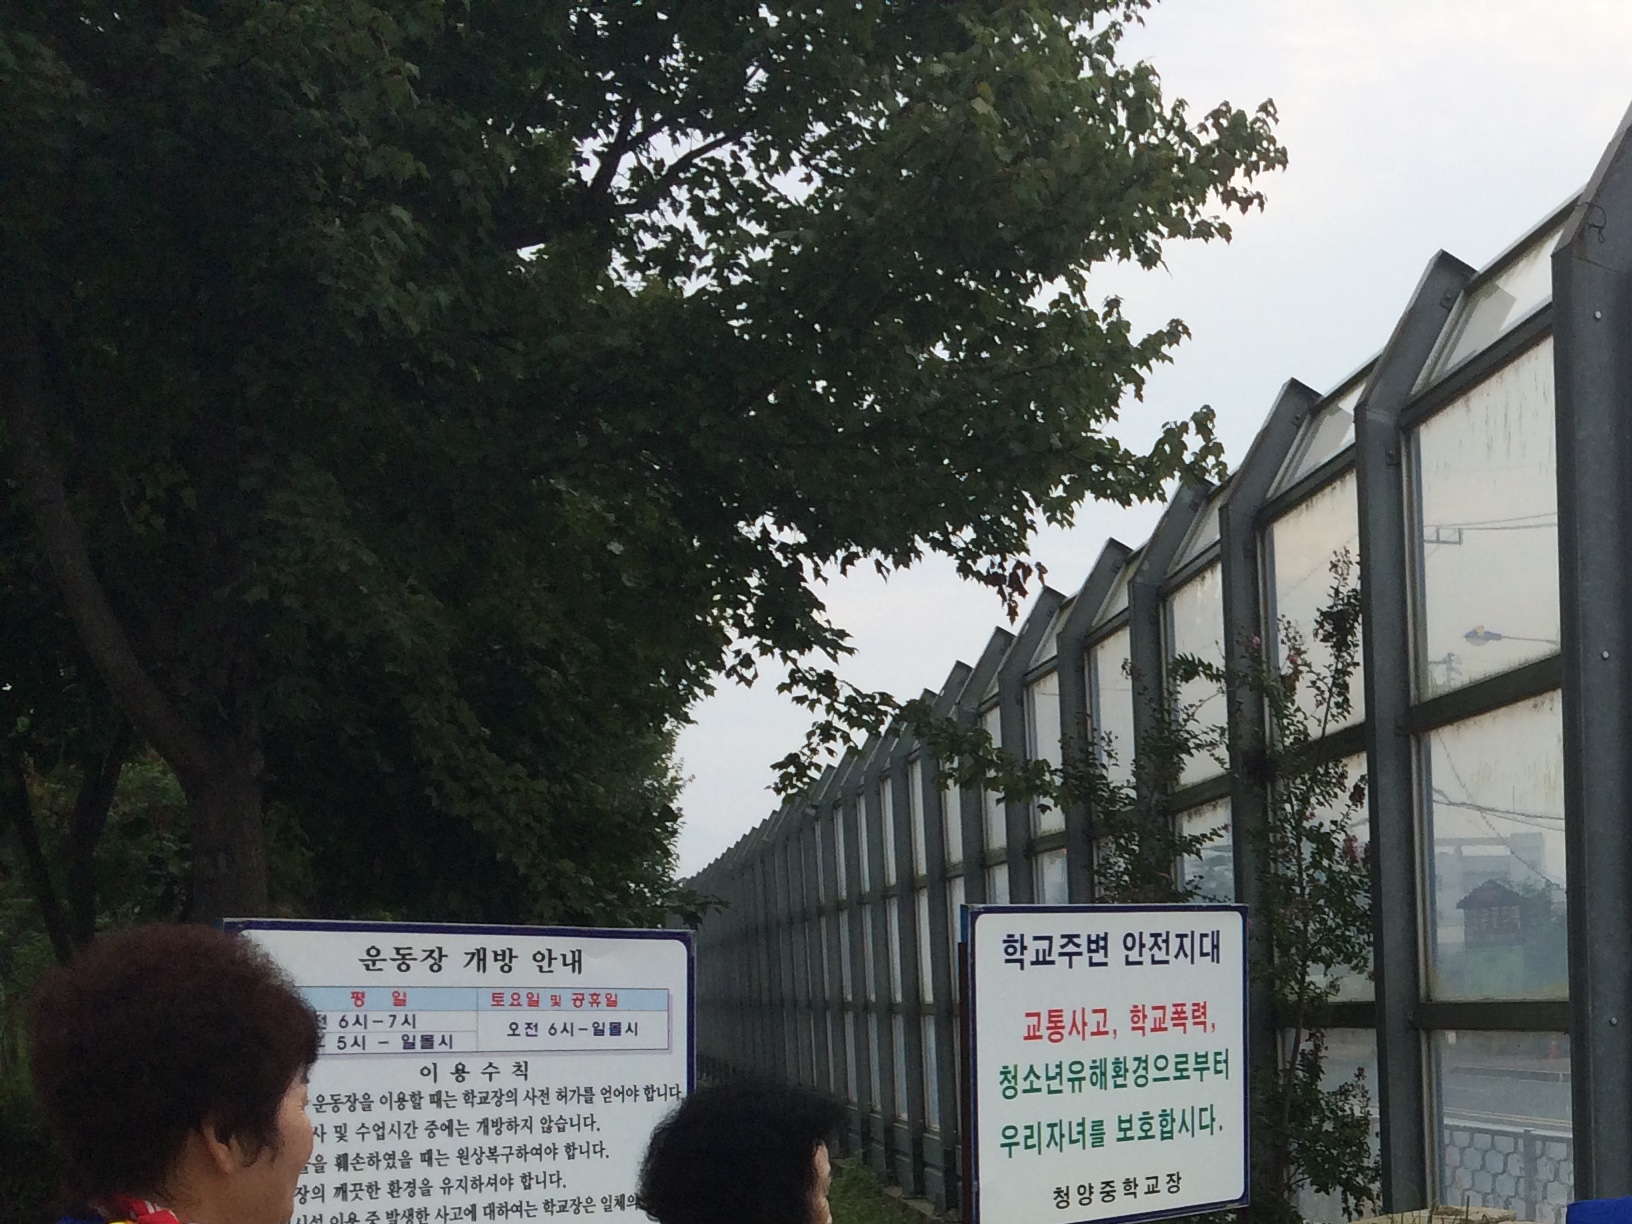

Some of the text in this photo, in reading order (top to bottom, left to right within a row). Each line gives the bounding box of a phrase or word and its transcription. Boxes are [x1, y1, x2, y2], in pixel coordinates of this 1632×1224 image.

[358, 945, 584, 975] 운동장 개방 안내
[1002, 929, 1222, 971] 학교주변 안전지대
[490, 991, 619, 1009] 토요일 및 공휴일
[506, 1021, 539, 1038] 오전
[1022, 1001, 1217, 1044] 교통사고, 학교폭력,
[998, 1048, 1230, 1101] 청소년유해환경으로부터
[312, 1091, 375, 1114] 운동장을
[379, 1091, 424, 1112] 이용할
[428, 1088, 458, 1109] 때는
[462, 1087, 518, 1108] 학교장의
[522, 1086, 551, 1107] 사전
[555, 1085, 596, 1105] 허가를
[600, 1084, 640, 1104] 얻어야
[333, 1122, 349, 1144] 및
[355, 1120, 419, 1143] 수업시간
[424, 1118, 470, 1139] 중에는
[476, 1116, 533, 1137] 개방하지
[539, 1113, 601, 1135] 않습니다.
[999, 1103, 1224, 1159] 우리자녀를 보호합시다.
[420, 1148, 450, 1168] 때는
[456, 1142, 559, 1166] 원상복구하여야
[564, 1140, 610, 1160] 합니다.
[333, 1180, 382, 1202] 깨끗한
[387, 1177, 433, 1199] 환경을
[439, 1173, 514, 1196] 유지하셔야
[519, 1170, 567, 1191] 합니다.
[1053, 1171, 1183, 1210] 청양중학교장
[434, 1203, 477, 1224] 사고에
[482, 1200, 539, 1222] 대하여는
[542, 1195, 597, 1217] 학교장은
